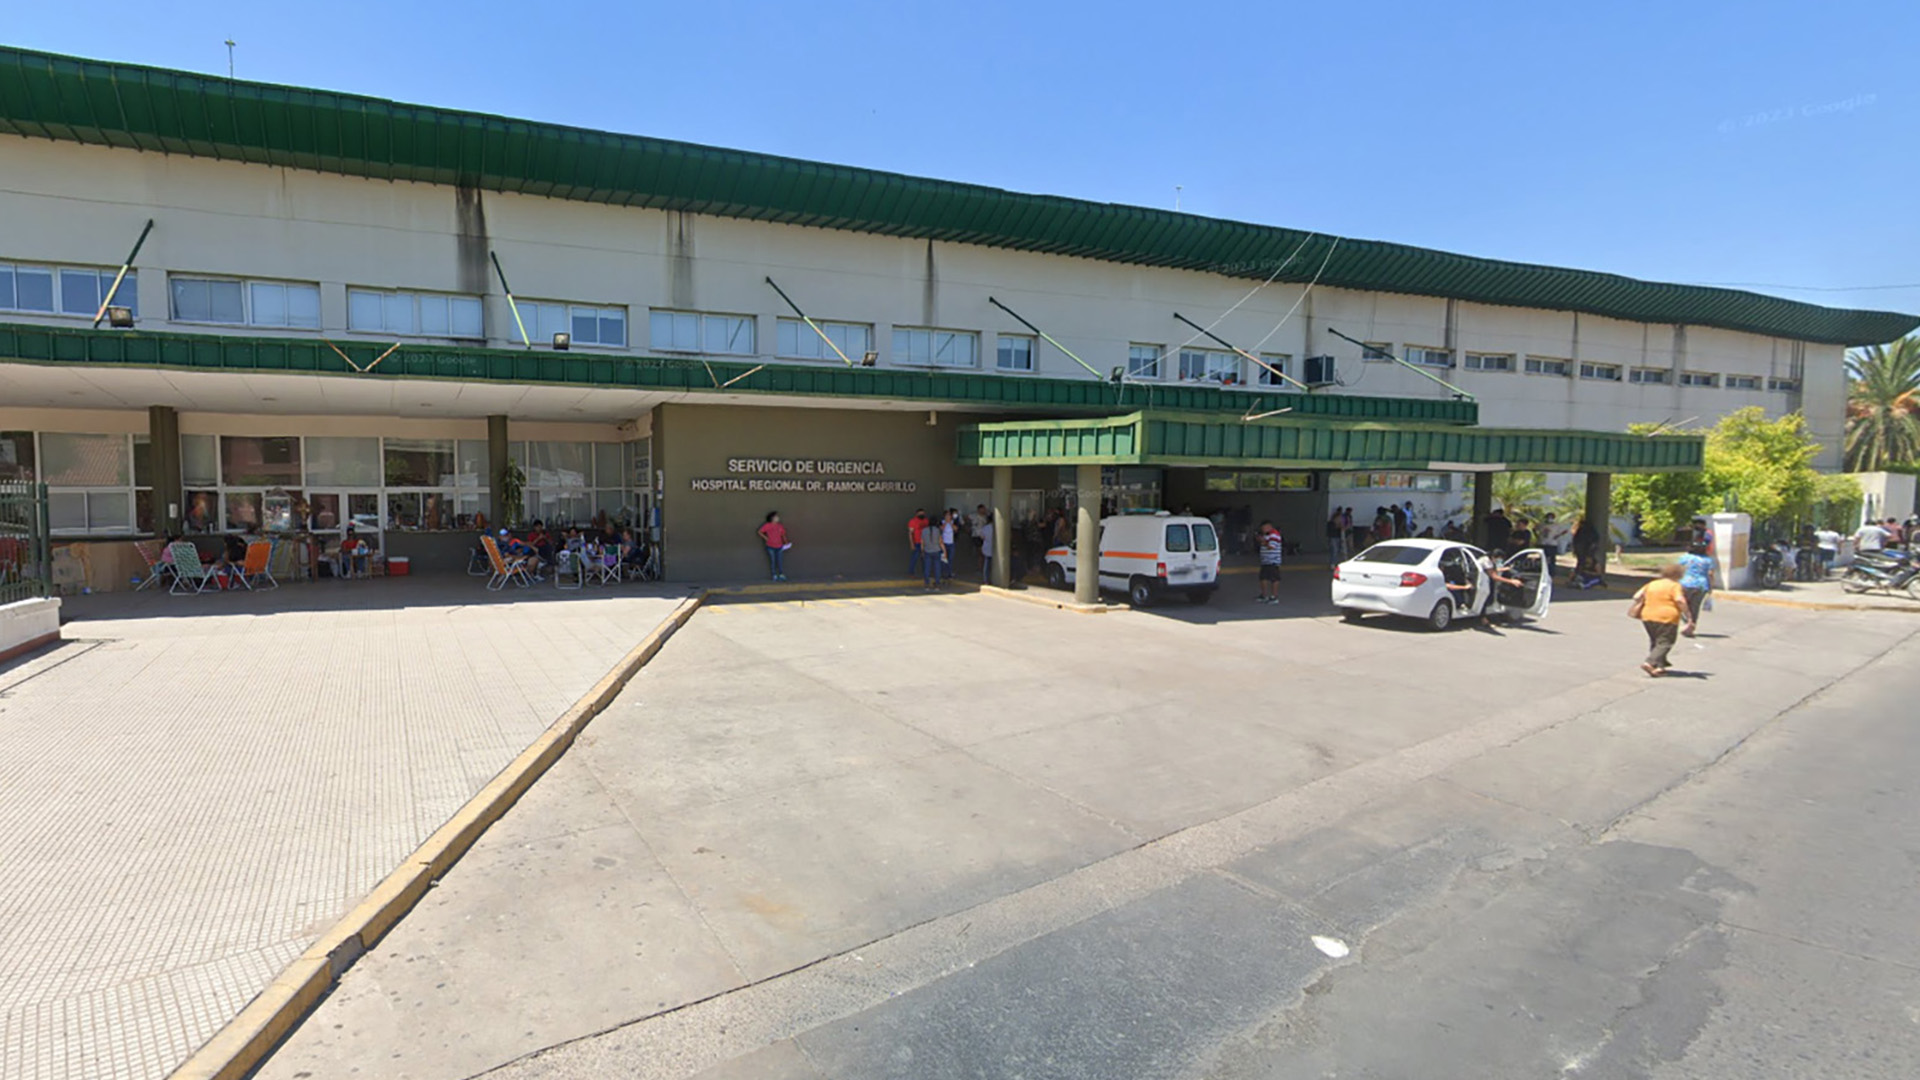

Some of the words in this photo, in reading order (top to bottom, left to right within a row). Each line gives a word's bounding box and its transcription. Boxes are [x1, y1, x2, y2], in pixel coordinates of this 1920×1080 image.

[728, 459, 793, 473] SERVICIO
[796, 461, 815, 473] DE
[817, 461, 884, 474] URGENCIA
[692, 480, 747, 491] HOSPITAL
[748, 480, 803, 491] REGIONAL
[805, 481, 825, 492] DR.
[826, 482, 865, 492] RAMON
[867, 482, 916, 493] CARRILLO
